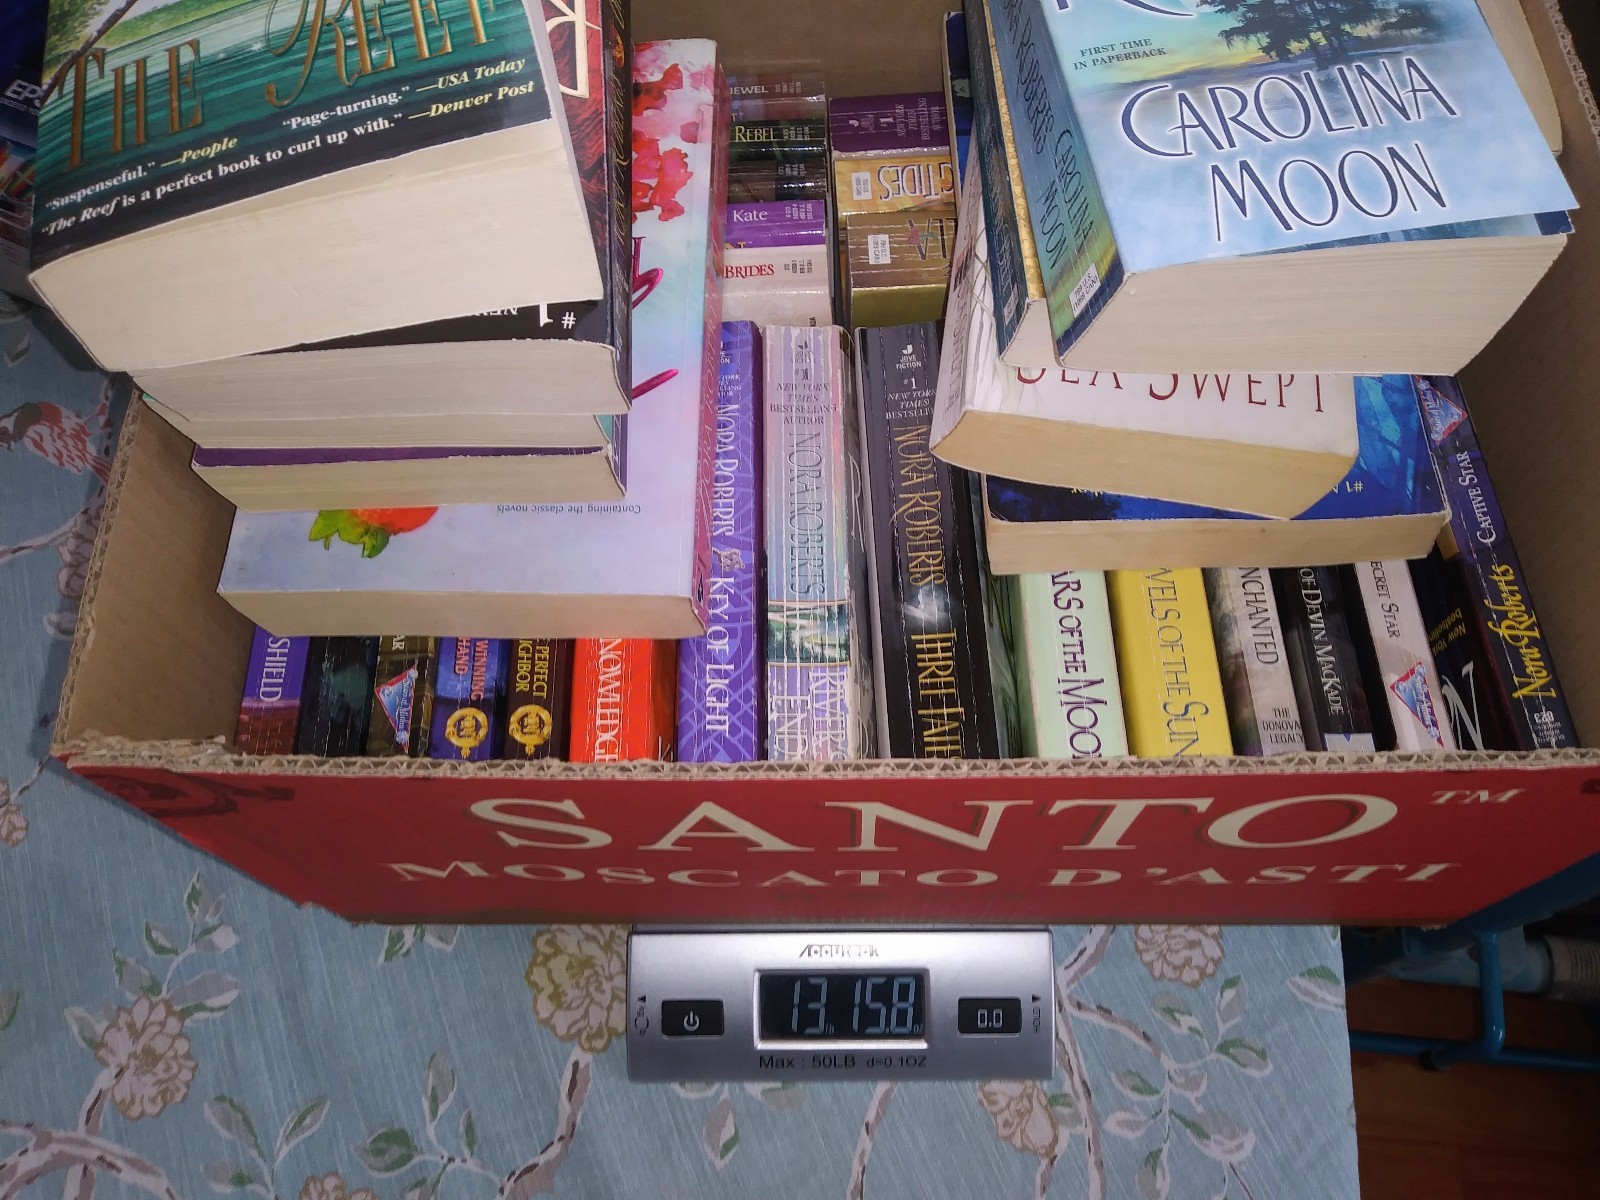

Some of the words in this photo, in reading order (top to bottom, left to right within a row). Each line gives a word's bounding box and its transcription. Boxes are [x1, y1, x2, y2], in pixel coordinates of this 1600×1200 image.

[475, 58, 525, 80] Today
[1073, 60, 1088, 70] IN
[1091, 47, 1168, 67] PAPERBACK
[1079, 43, 1115, 57] FIRST
[1119, 38, 1153, 51] TIME
[57, 38, 203, 171] THE
[1016, 18, 1055, 155] ROBERTS
[1121, 57, 1458, 157] CAROLINA
[80, 197, 119, 220] Reef
[121, 193, 136, 209] is
[140, 189, 152, 202] a
[156, 168, 214, 198] perfect
[217, 155, 262, 177] book
[265, 149, 283, 163] to
[287, 135, 322, 155] curl
[326, 130, 349, 149] up
[498, 80, 536, 101] Post
[735, 126, 775, 143] REBEL
[1055, 129, 1095, 251] CAROLINA
[1210, 142, 1448, 242] MOON
[733, 208, 769, 222] Kate
[1039, 180, 1069, 270] MOON
[723, 263, 775, 280] BRIDES
[888, 391, 911, 401] NEW
[716, 404, 740, 453] NORA
[788, 432, 822, 496] NORA
[893, 425, 935, 487] NORA
[1457, 450, 1478, 486] STAR
[497, 504, 528, 513] novels
[531, 504, 564, 513] classic
[568, 504, 584, 513] the
[588, 504, 641, 514] Containing
[711, 459, 739, 537] ROBERTS
[1468, 487, 1497, 544] CAPTIVE
[789, 500, 825, 595] ROBERTS
[889, 490, 945, 587] ROBERTS
[1058, 614, 1084, 638] OF
[1381, 602, 1400, 639] STAR
[1483, 564, 1541, 647] Roberts
[706, 625, 730, 656] OF
[1062, 640, 1087, 674] THE
[1157, 625, 1185, 653] OF
[259, 636, 291, 703] SHIELD
[470, 639, 489, 702] WINNING
[532, 645, 550, 700] PERFECT
[910, 628, 957, 703] THREE
[1162, 655, 1192, 697] THE
[1512, 645, 1557, 699] Nora
[705, 662, 735, 738] LIGHT
[1057, 677, 1108, 759] MOO
[1271, 707, 1291, 718] THE
[917, 707, 965, 759] FATE
[1262, 720, 1302, 731] DONOVA
[470, 793, 1398, 853] SANTO
[388, 860, 999, 887] MOSCATO
[1049, 863, 1463, 887] D'ASTI
[976, 1008, 1003, 1029] 0.0
[759, 1055, 795, 1068] Max
[812, 1055, 856, 1068] 50LB
